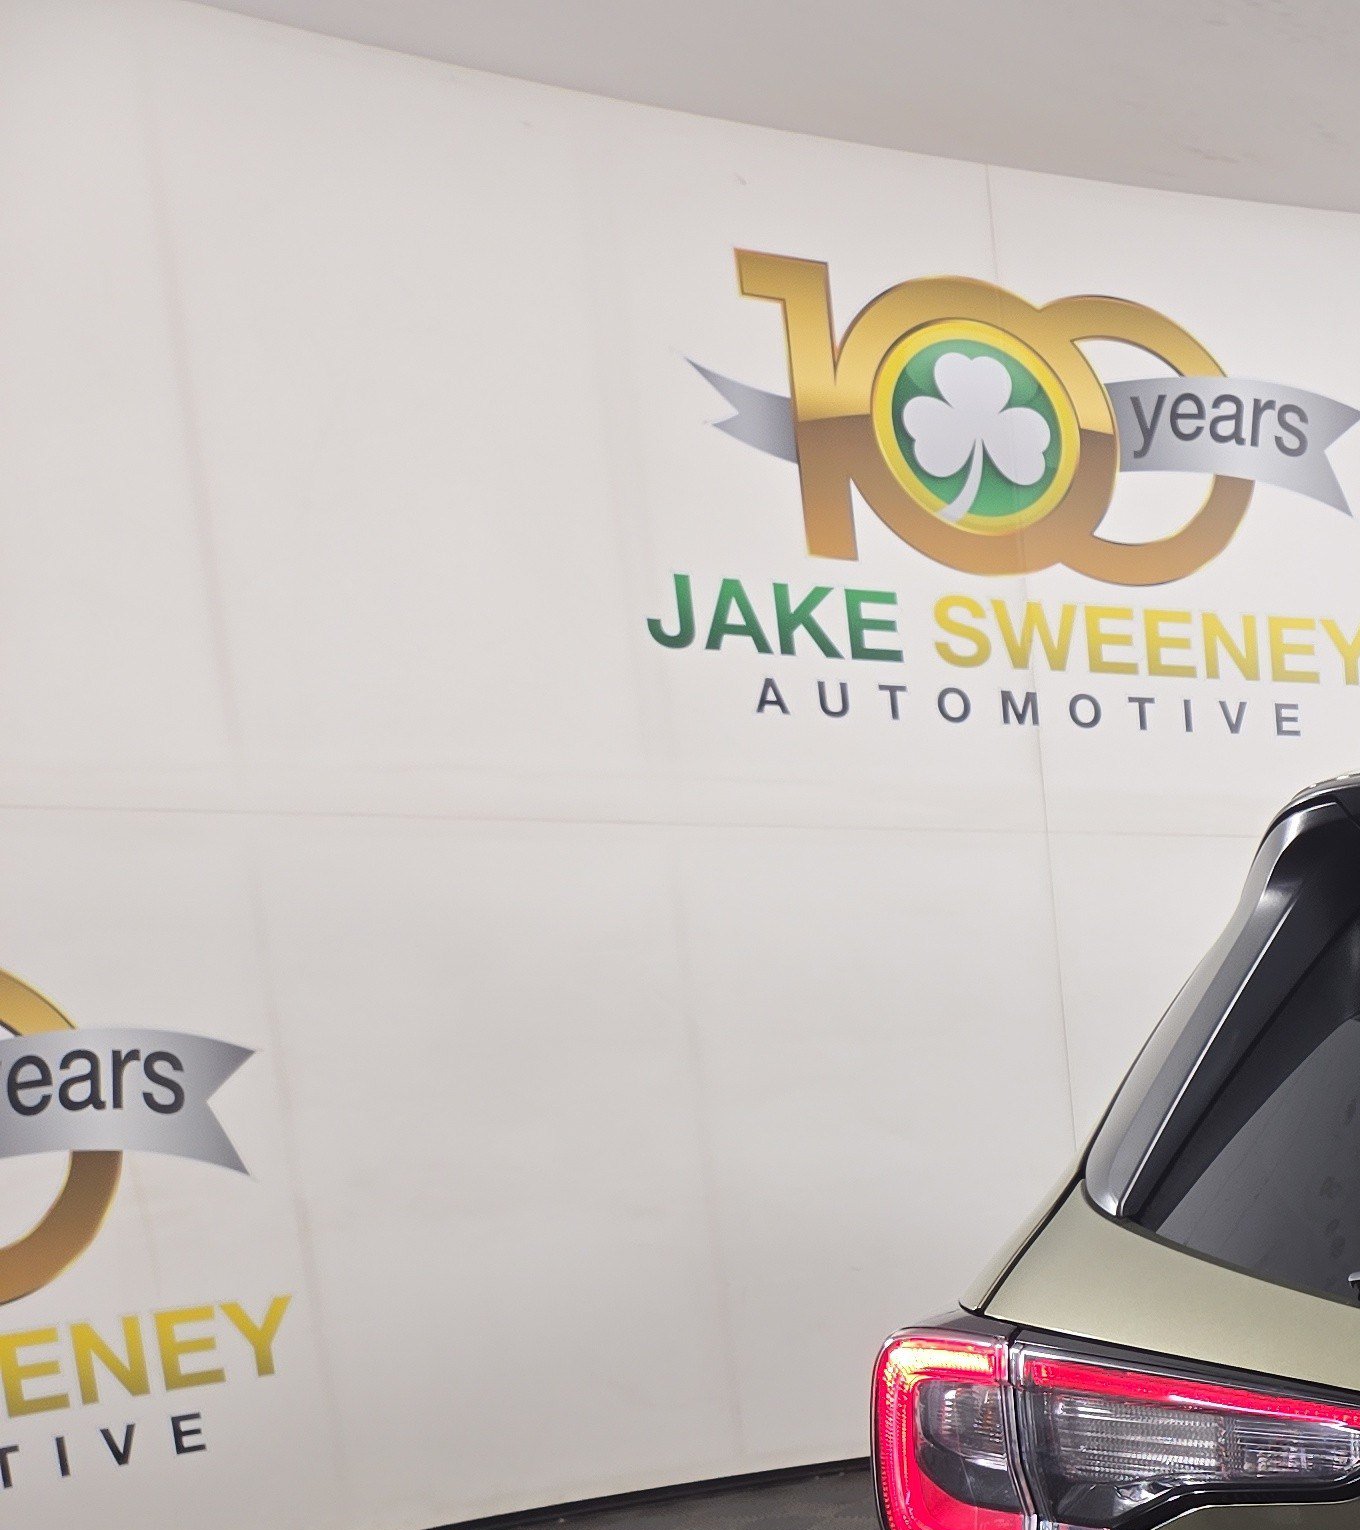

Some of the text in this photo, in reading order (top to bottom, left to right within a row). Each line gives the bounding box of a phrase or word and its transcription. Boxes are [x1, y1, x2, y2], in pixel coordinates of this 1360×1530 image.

[734, 248, 1311, 587] 100 years
[646, 574, 905, 664] JAKE
[755, 676, 1302, 738] AUTOMOTIVE
[0, 1047, 186, 1117] ears
[0, 1294, 293, 1418] ENEY
[0, 1412, 207, 1489] TIVE
